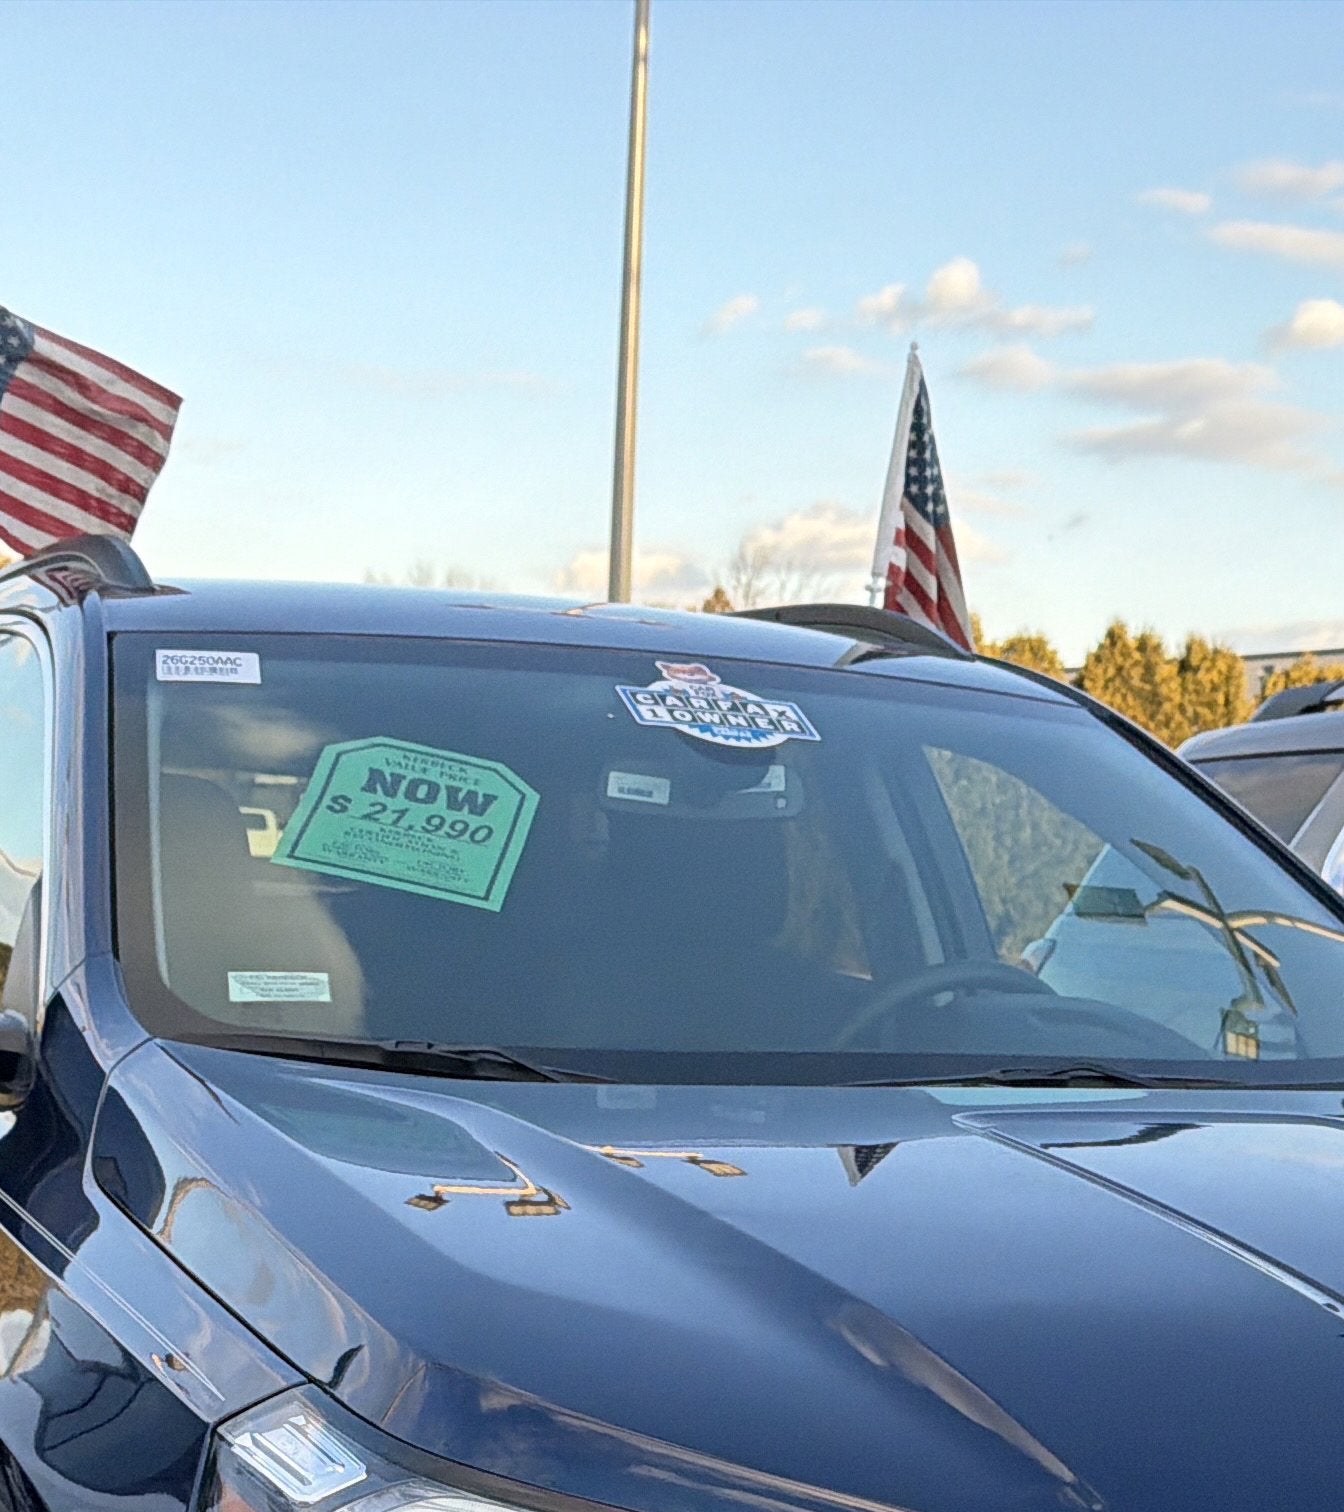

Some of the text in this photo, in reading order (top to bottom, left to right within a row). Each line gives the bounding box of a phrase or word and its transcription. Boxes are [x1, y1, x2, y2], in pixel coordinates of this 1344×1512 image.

[636, 692, 796, 721] CARFAX
[672, 710, 802, 733] OWNER
[361, 767, 499, 818] NOW
[359, 802, 495, 845] 21,990
